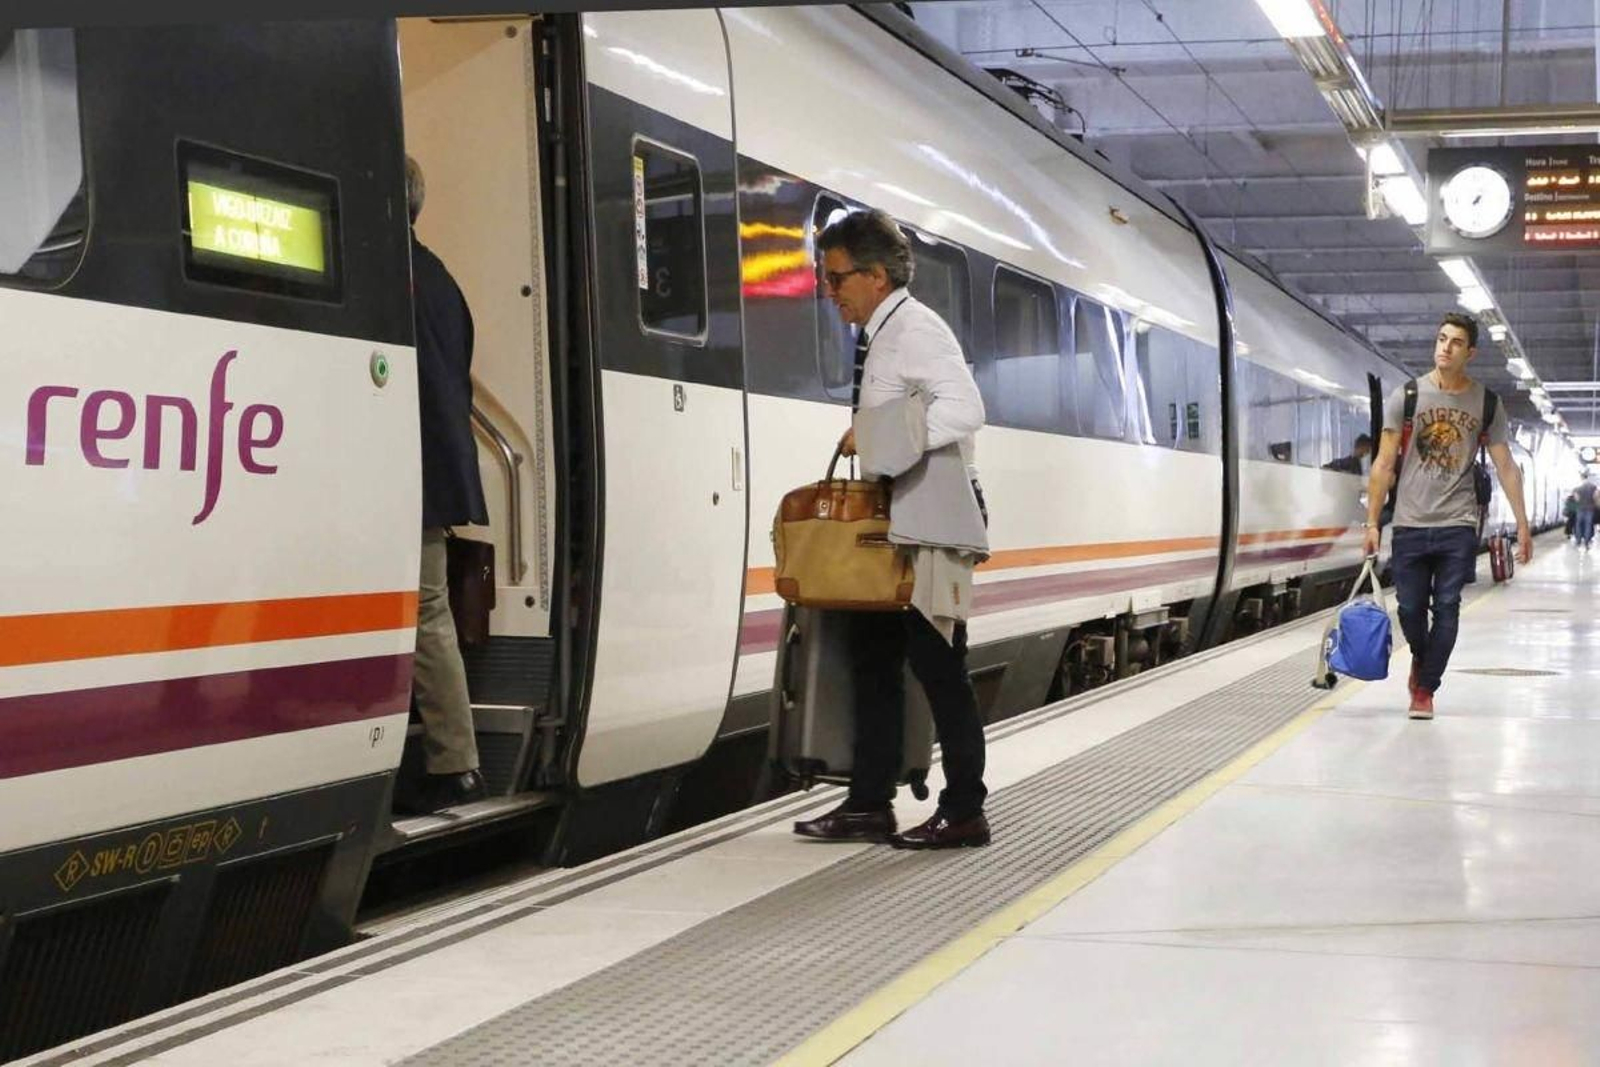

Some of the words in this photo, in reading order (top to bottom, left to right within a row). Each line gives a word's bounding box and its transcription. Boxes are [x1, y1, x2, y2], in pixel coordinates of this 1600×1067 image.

[1417, 407, 1478, 432] TIGERS
[25, 350, 284, 525] renfe
[91, 844, 137, 877] SW-R
